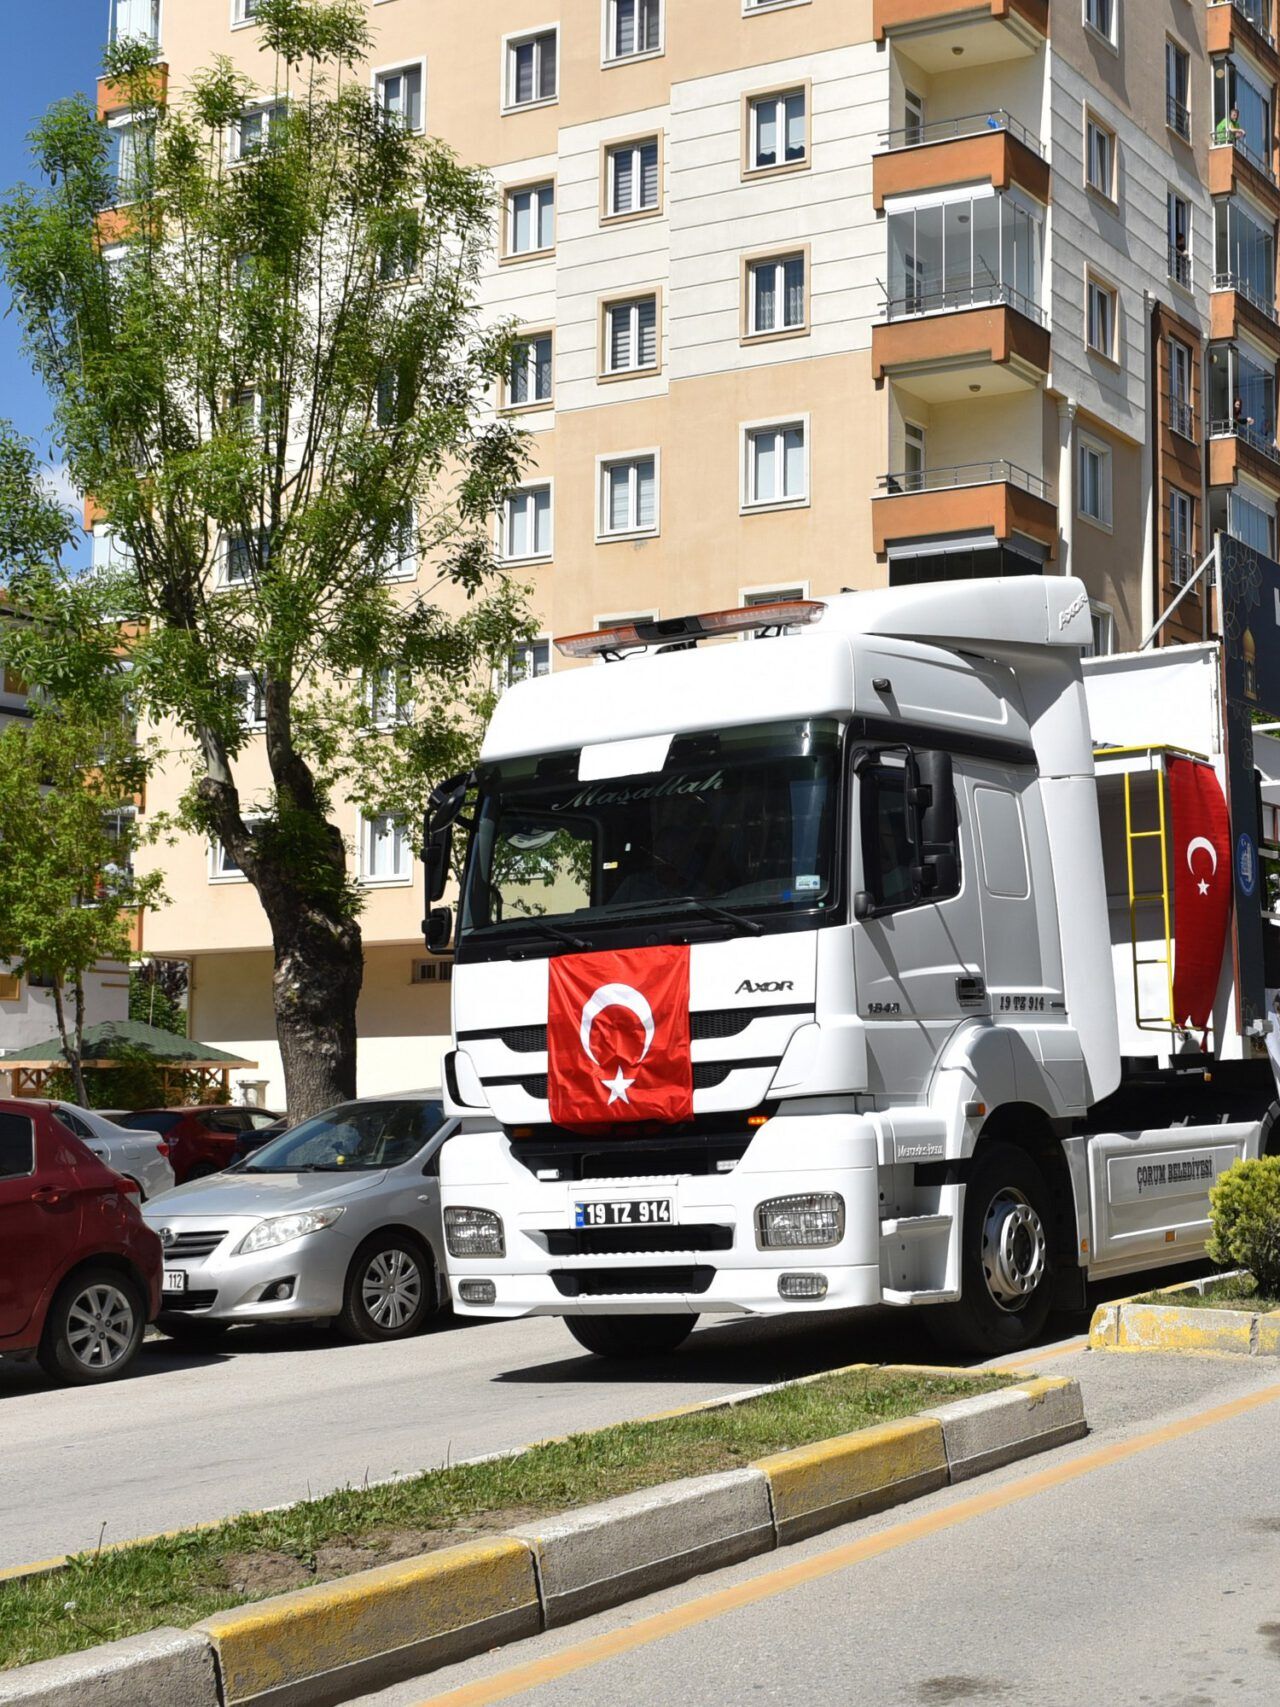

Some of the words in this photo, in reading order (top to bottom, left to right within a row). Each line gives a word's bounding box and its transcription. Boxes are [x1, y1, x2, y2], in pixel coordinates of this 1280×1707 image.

[1000, 996, 1011, 1011] 19
[1013, 996, 1027, 1011] TZ
[1028, 996, 1044, 1011] 914
[1137, 1164, 1166, 1193] ÇORUM
[1167, 1155, 1213, 1182] BELEDİYESİ
[587, 1204, 606, 1224] 19
[610, 1202, 632, 1223] TZ
[639, 1201, 670, 1222] 914
[169, 1273, 183, 1289] 112
